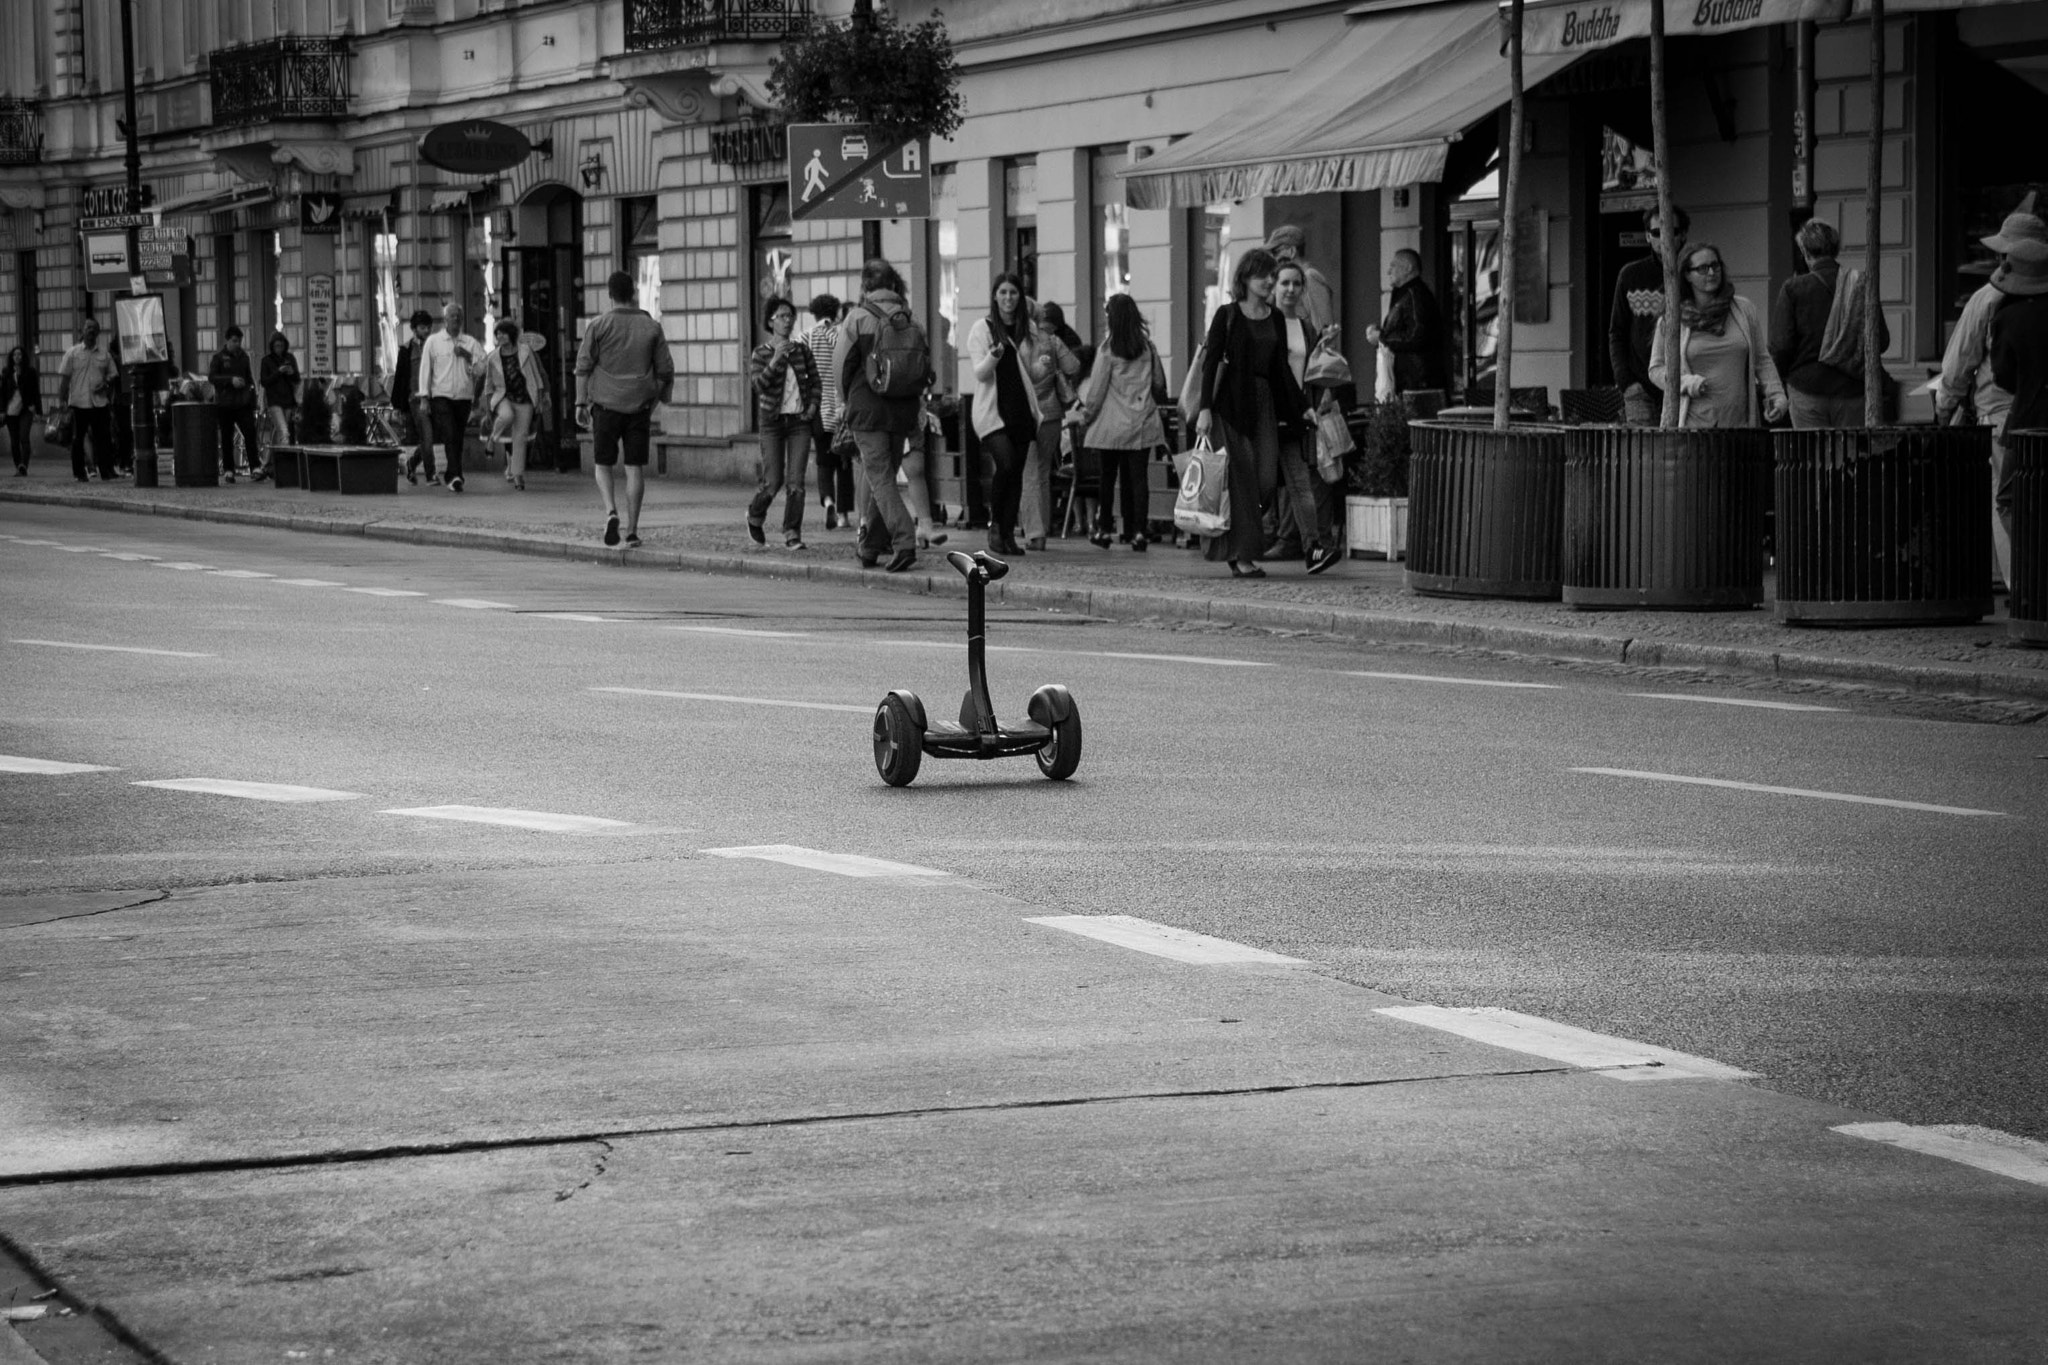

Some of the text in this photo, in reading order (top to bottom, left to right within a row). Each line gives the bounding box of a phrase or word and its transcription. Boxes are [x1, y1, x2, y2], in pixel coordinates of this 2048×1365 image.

[1561, 7, 1621, 47] Buddha
[1692, 0, 1763, 26] Buddha
[753, 125, 782, 161] KING
[84, 189, 110, 217] COSTA
[98, 216, 138, 227] FOKSAL
